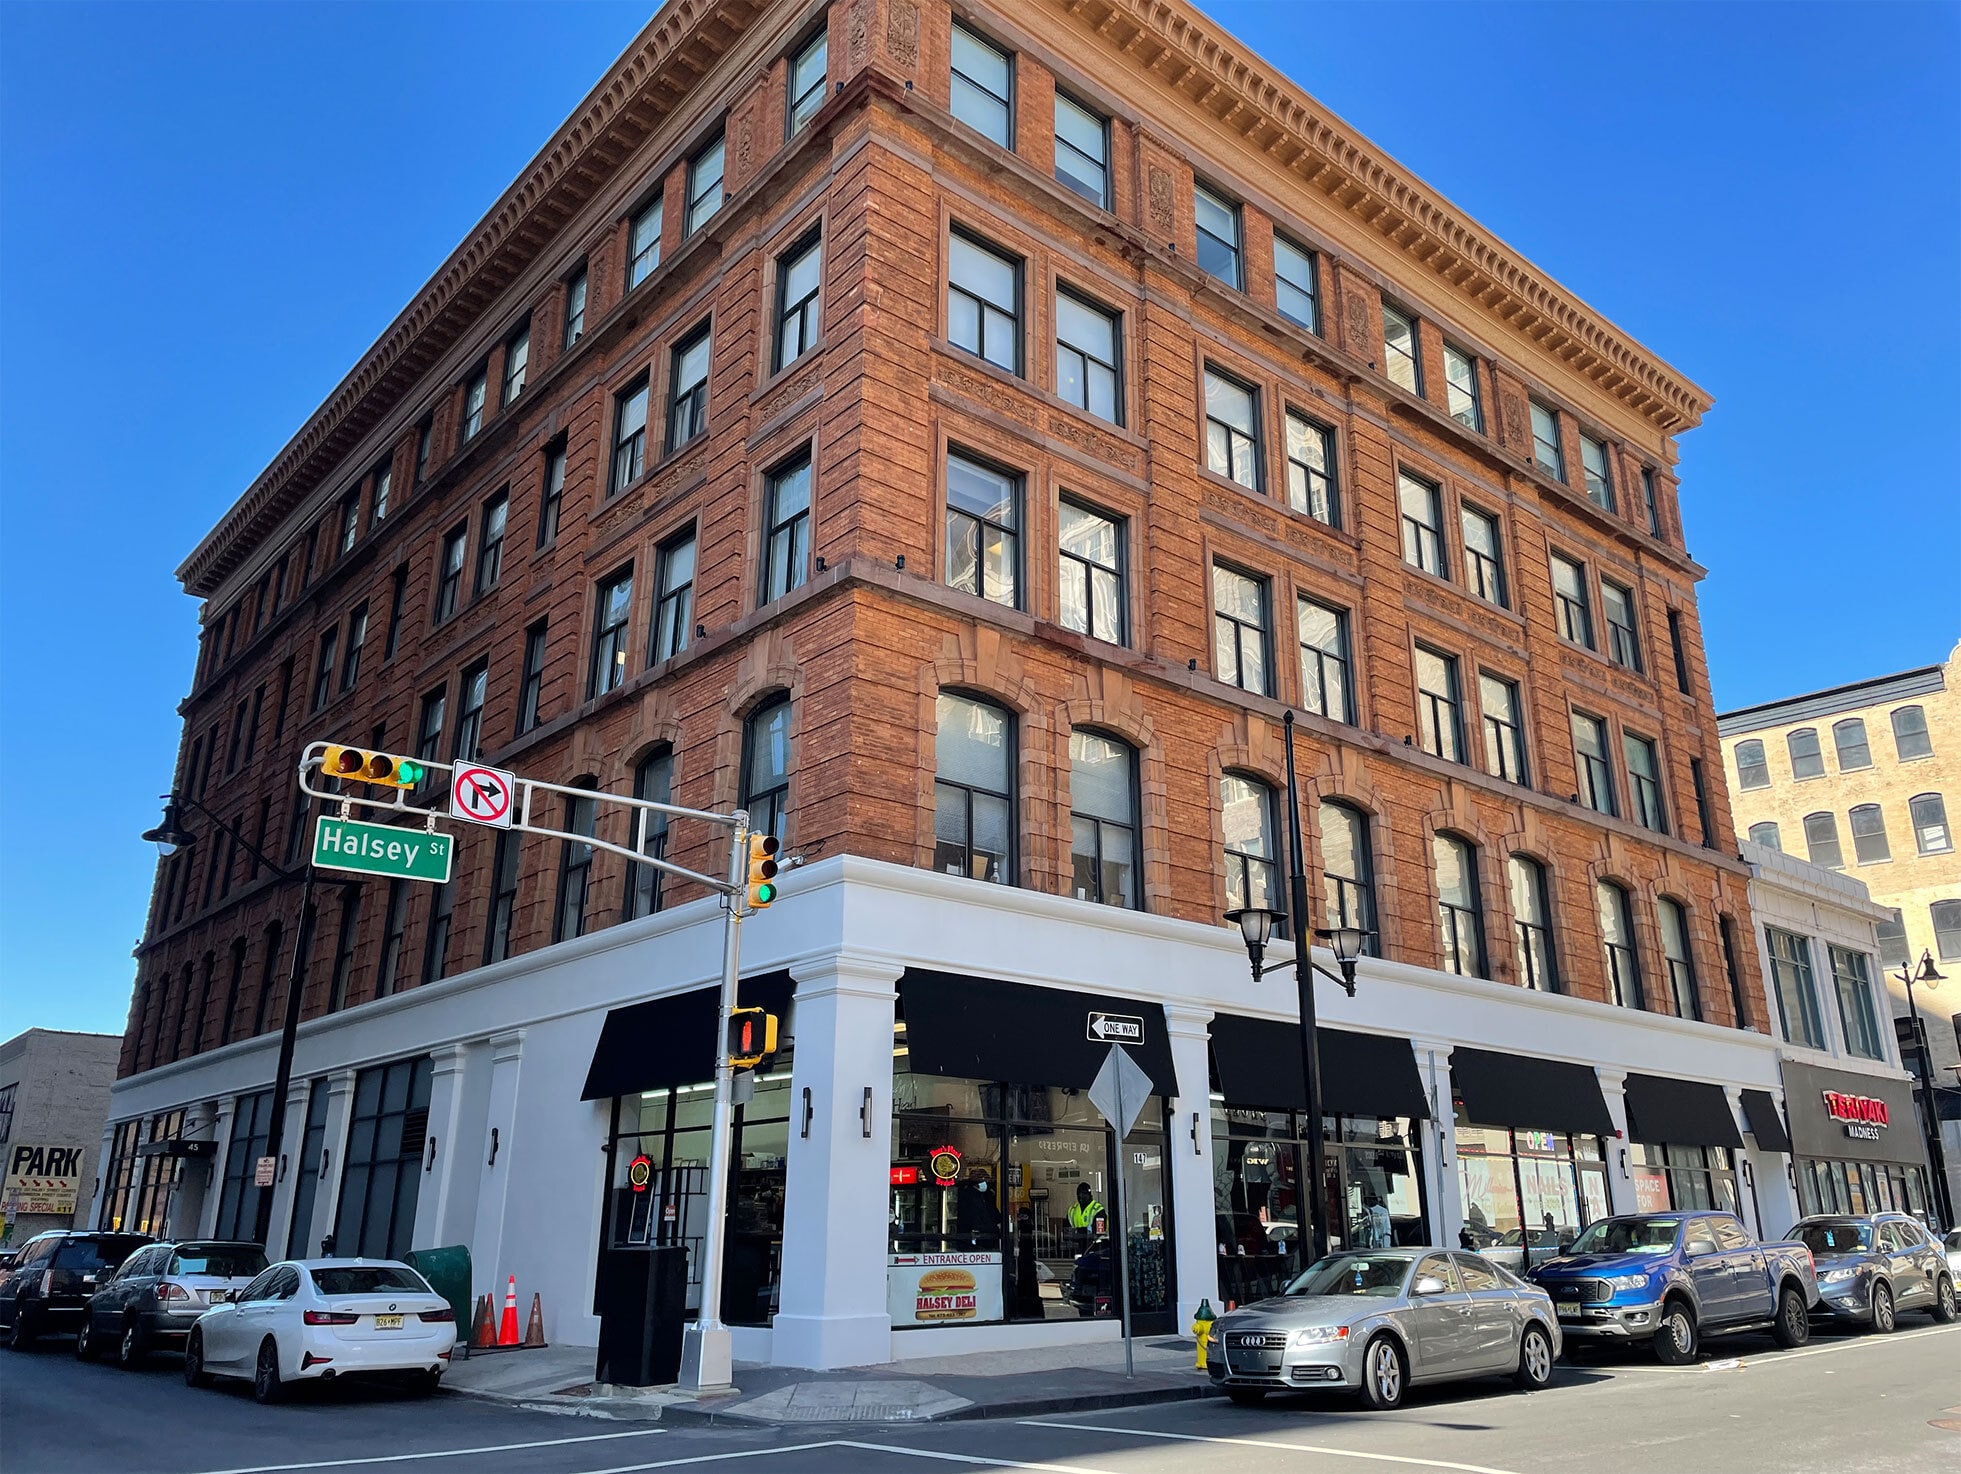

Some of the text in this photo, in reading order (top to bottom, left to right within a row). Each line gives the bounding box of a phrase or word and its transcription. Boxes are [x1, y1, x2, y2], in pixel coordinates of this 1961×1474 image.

[322, 826, 445, 868] Halsey St
[1104, 1022, 1138, 1035] ONE WAY
[1824, 1092, 1889, 1125] TERIYAKI
[1847, 1125, 1880, 1140] MADNESS
[1526, 1131, 1555, 1151] OPEN
[11, 1146, 83, 1178] PARK
[1134, 1153, 1146, 1163] 147
[1525, 1174, 1569, 1197] NAILS
[1634, 1179, 1660, 1193] SPACE
[30, 1202, 54, 1212] SPECIAL
[1637, 1195, 1653, 1208] FOR
[923, 1254, 991, 1264] ENTRANCE OPEN
[916, 1296, 976, 1310] HALSEY DELI
